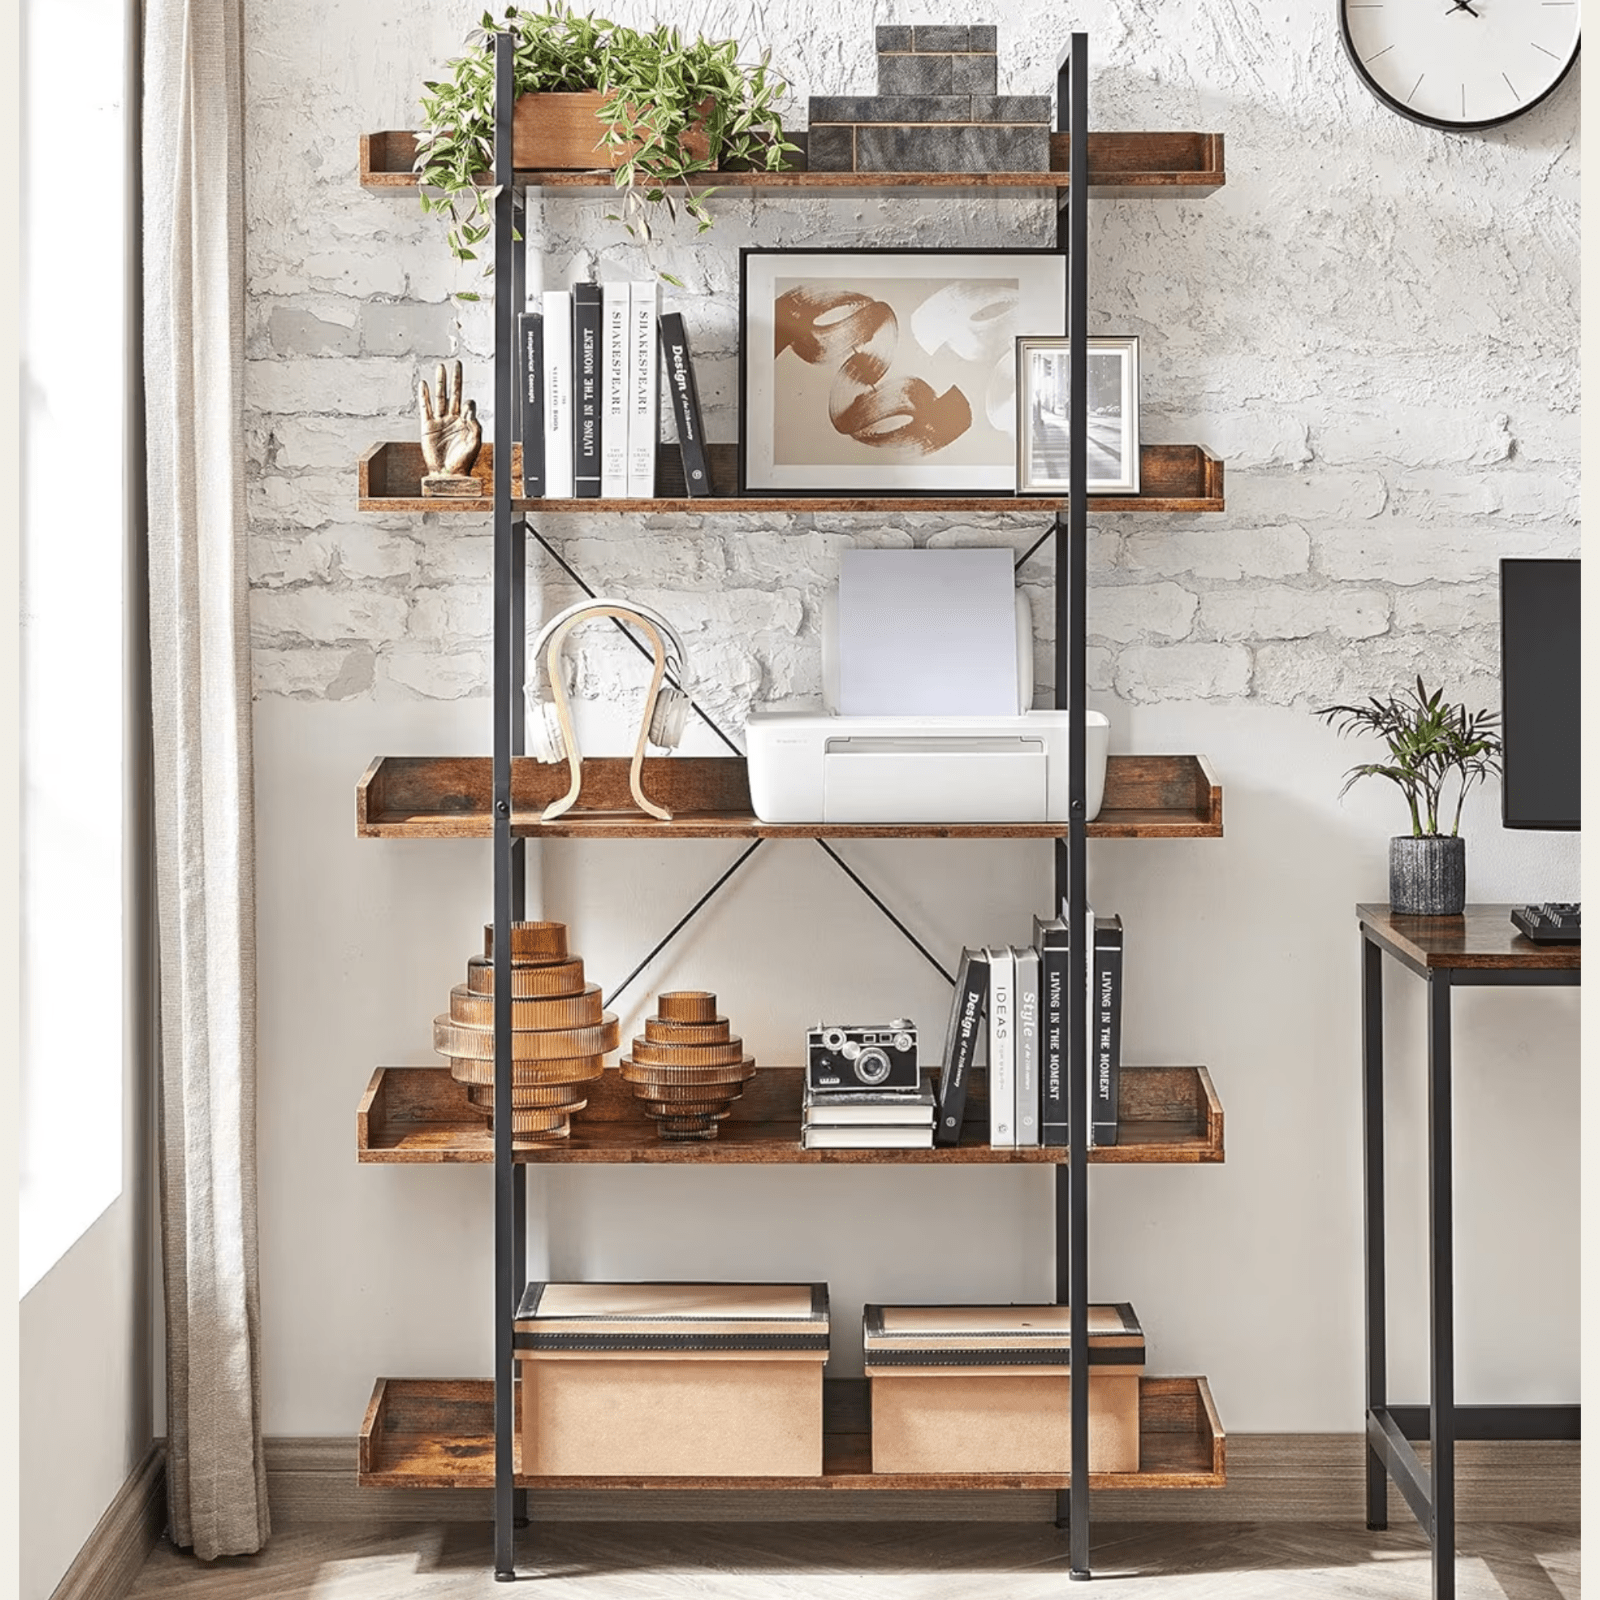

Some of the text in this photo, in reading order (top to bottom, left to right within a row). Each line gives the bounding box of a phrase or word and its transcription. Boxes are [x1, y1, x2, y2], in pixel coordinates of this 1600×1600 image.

[583, 328, 594, 457] LIVING IN THE MOMENT
[611, 311, 621, 415] SHAKESPEARE
[638, 311, 648, 415] SHAKESPEARE
[672, 345, 688, 391] Design
[961, 992, 979, 1038] Design
[996, 986, 1007, 1040] IDEAS
[1020, 992, 1035, 1037] Style
[1049, 972, 1061, 1100] LIVING IN THE MOMENT
[1100, 972, 1112, 1100] LIVING IN THE MOMENT
